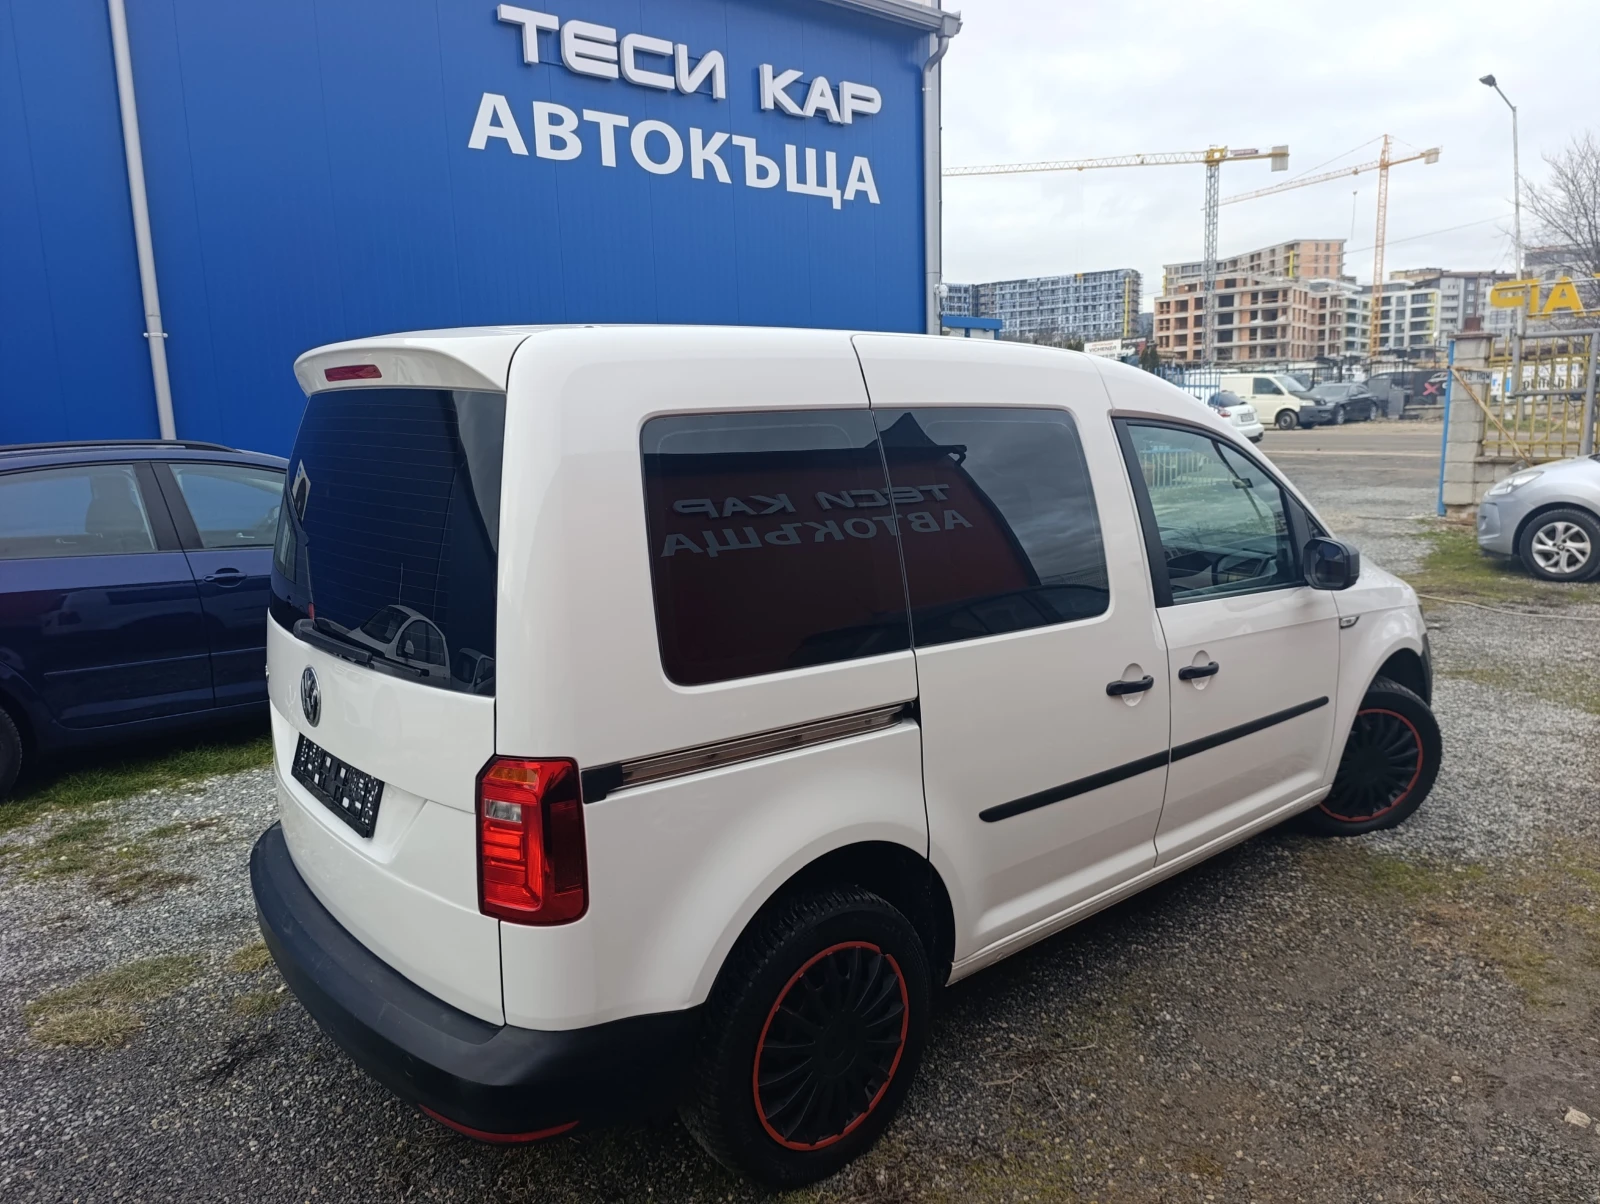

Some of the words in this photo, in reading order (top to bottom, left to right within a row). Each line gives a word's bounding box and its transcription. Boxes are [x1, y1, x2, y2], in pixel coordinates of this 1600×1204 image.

[497, 4, 726, 100] ТЕСИ
[759, 63, 882, 125] КАР
[467, 92, 881, 210] АВТОКЪЩА
